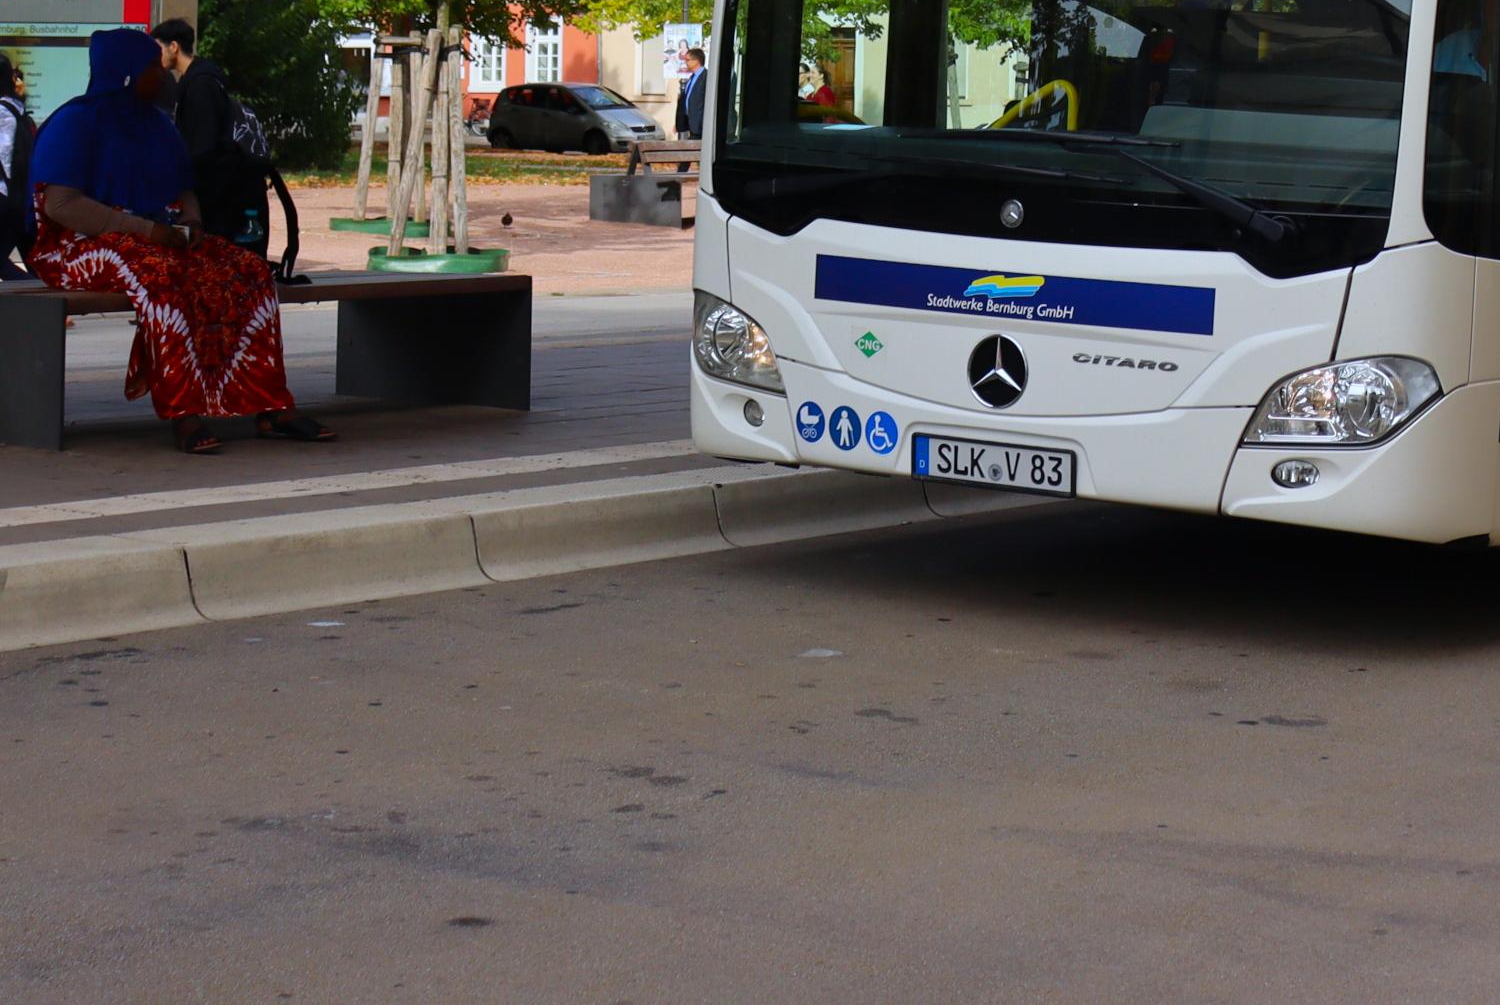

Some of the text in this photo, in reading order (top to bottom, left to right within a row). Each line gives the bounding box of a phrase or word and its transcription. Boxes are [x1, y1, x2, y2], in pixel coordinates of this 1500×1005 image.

[926, 293, 1075, 320] Stadtwerke Bernburg GmbH
[857, 338, 881, 353] CNG
[1072, 352, 1180, 372] CITARO
[920, 459, 926, 469] D
[936, 443, 1063, 487] SLK V 83
